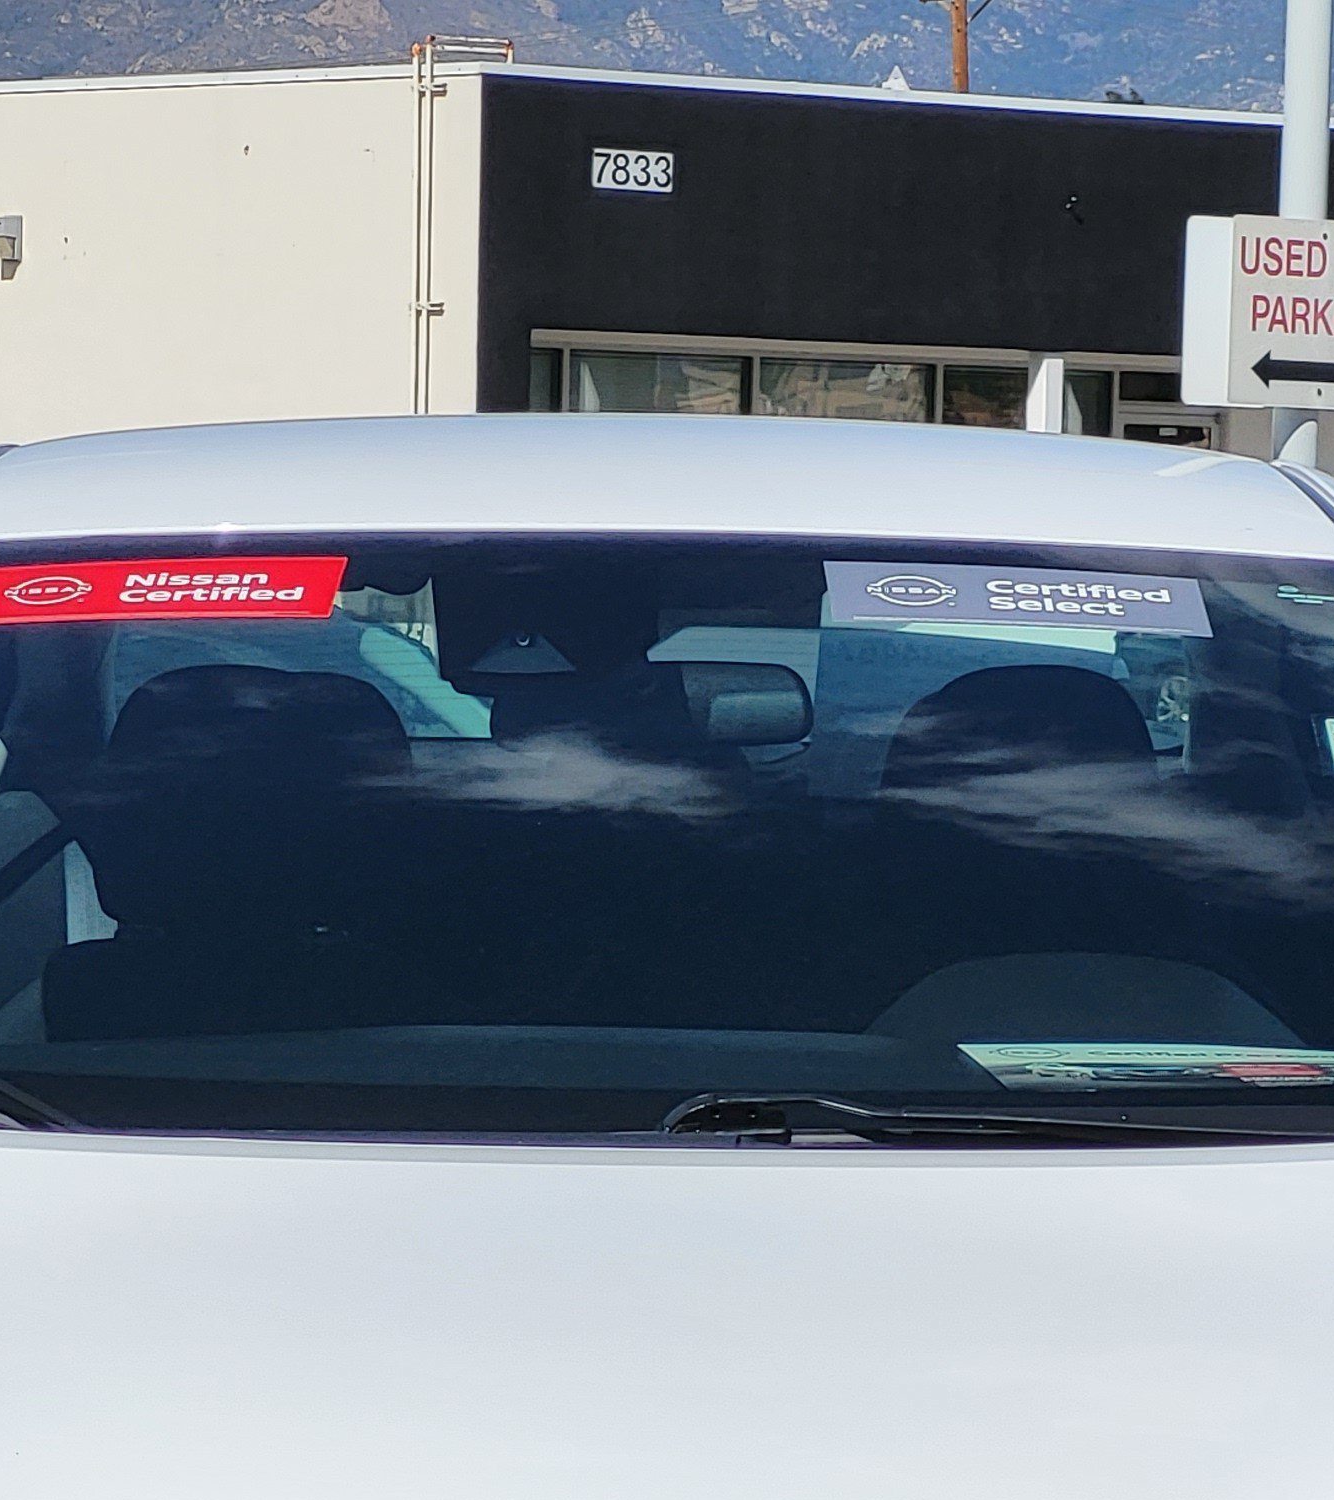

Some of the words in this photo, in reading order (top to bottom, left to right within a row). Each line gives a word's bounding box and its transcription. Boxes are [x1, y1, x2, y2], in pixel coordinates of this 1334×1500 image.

[594, 152, 671, 187] 7833
[1240, 235, 1327, 278] USED
[124, 571, 268, 587] Nissan
[4, 582, 93, 598] NISSAN
[118, 585, 305, 604] Certified
[866, 583, 957, 598] NISSAN
[985, 580, 1172, 603] Certified
[988, 596, 1126, 616] Select
